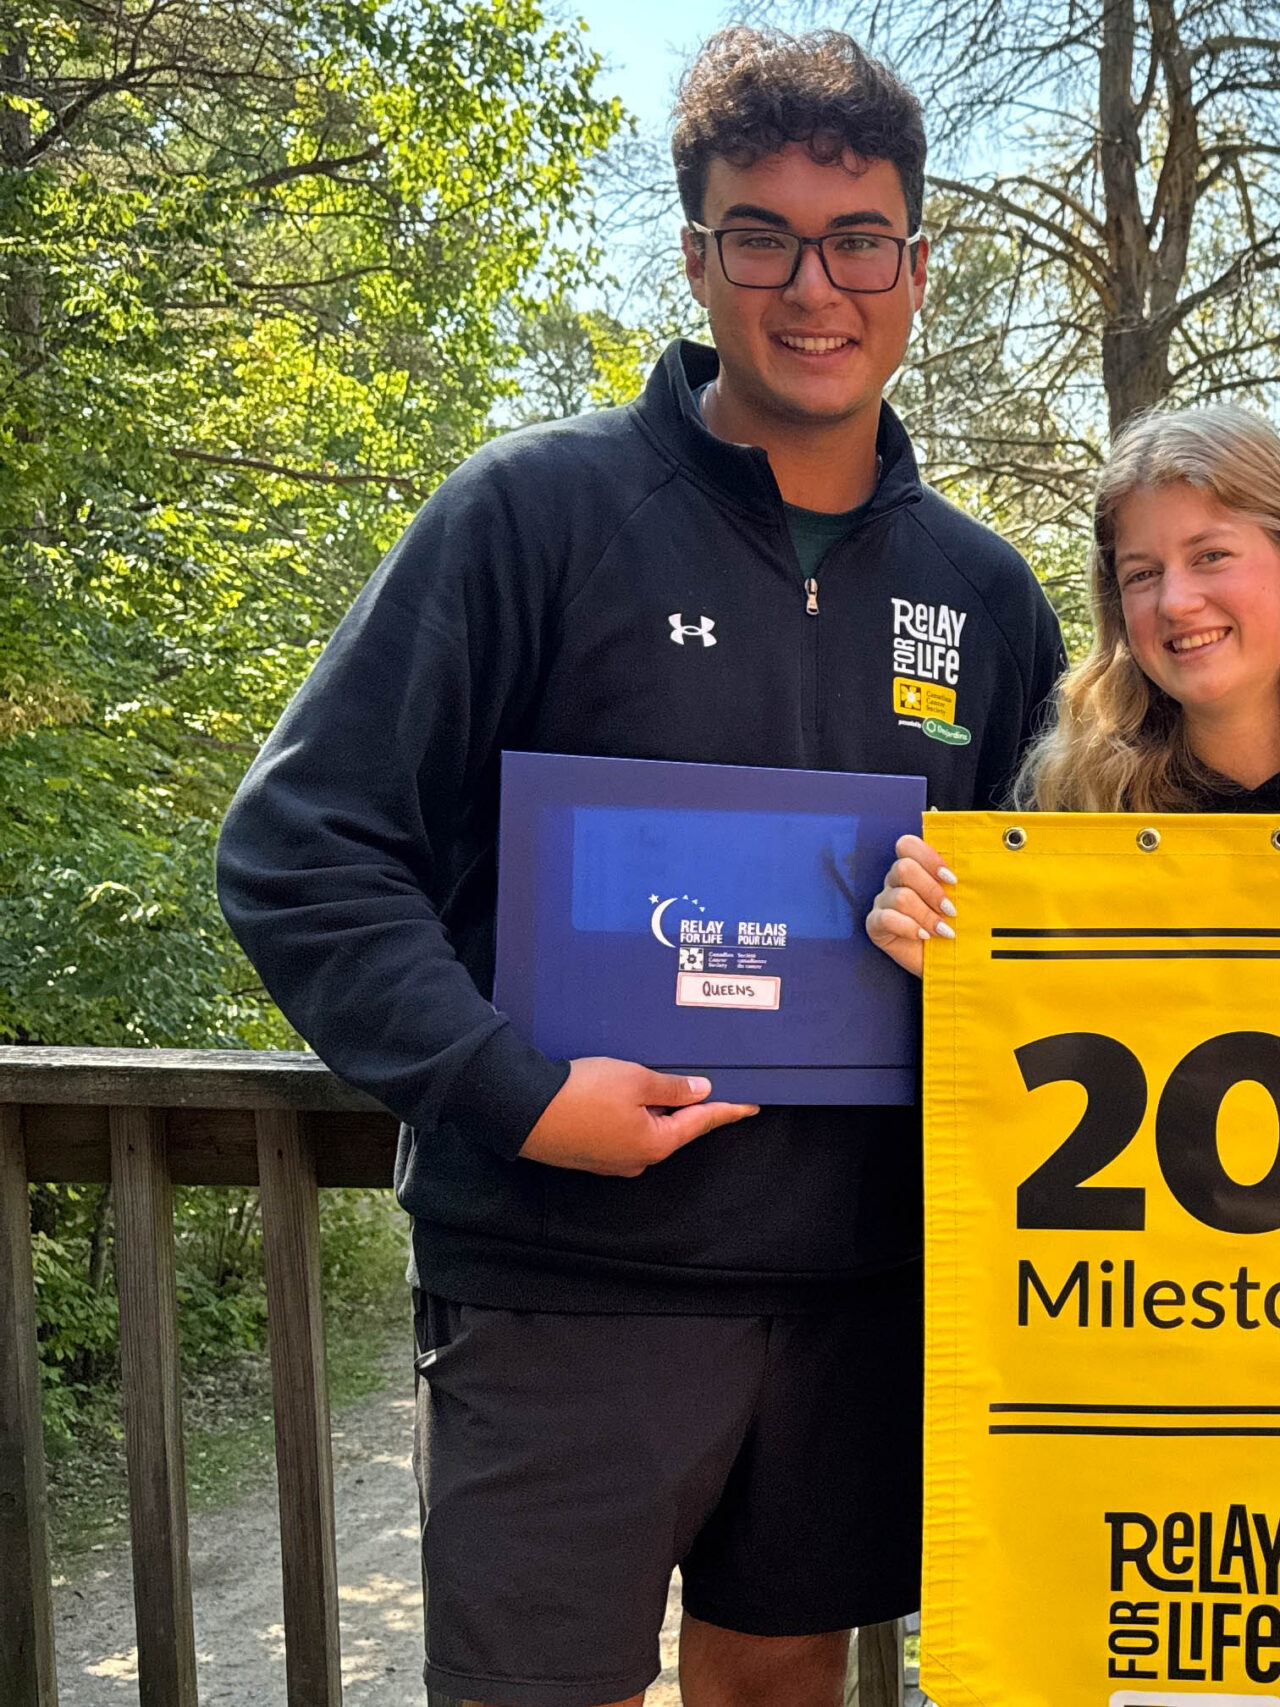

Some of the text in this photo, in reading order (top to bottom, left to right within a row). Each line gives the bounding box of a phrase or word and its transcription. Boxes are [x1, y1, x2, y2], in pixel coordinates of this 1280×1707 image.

[893, 637, 916, 675] FOR
[680, 919, 724, 934] RELAY
[738, 921, 787, 936] RELAIS
[680, 933, 723, 944] FOR LIFE
[737, 935, 786, 947] POUR LA VIE
[702, 981, 755, 997] QUEENS
[1108, 1600, 1160, 1680] FOR
